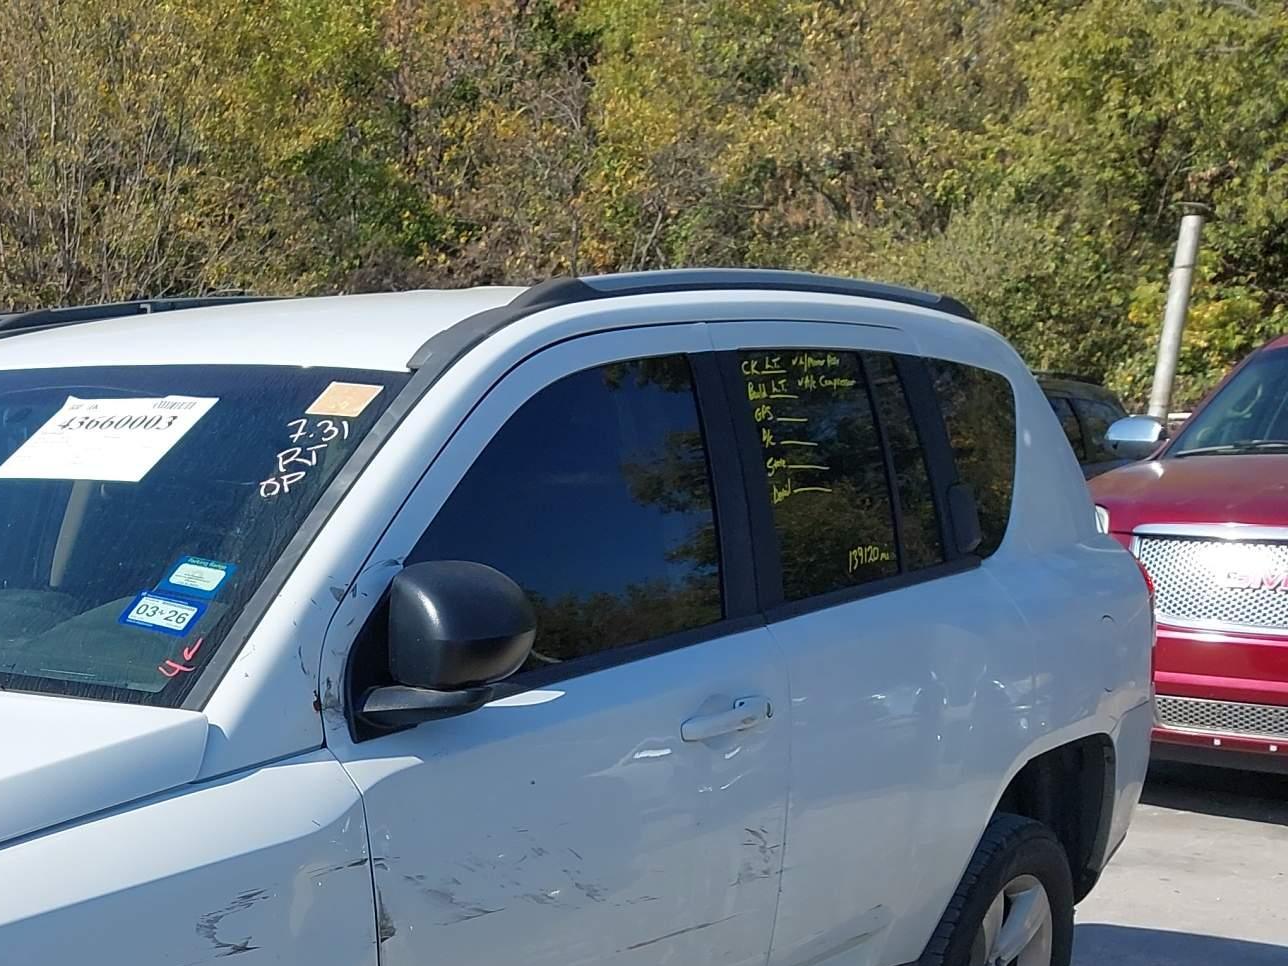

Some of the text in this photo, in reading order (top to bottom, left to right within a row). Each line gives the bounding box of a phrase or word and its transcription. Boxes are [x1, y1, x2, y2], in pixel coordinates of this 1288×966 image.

[58, 414, 179, 431] 43660003
[287, 418, 349, 443] 7.31
[276, 443, 328, 472] RT
[135, 603, 160, 618] 03
[163, 609, 190, 625] 26
